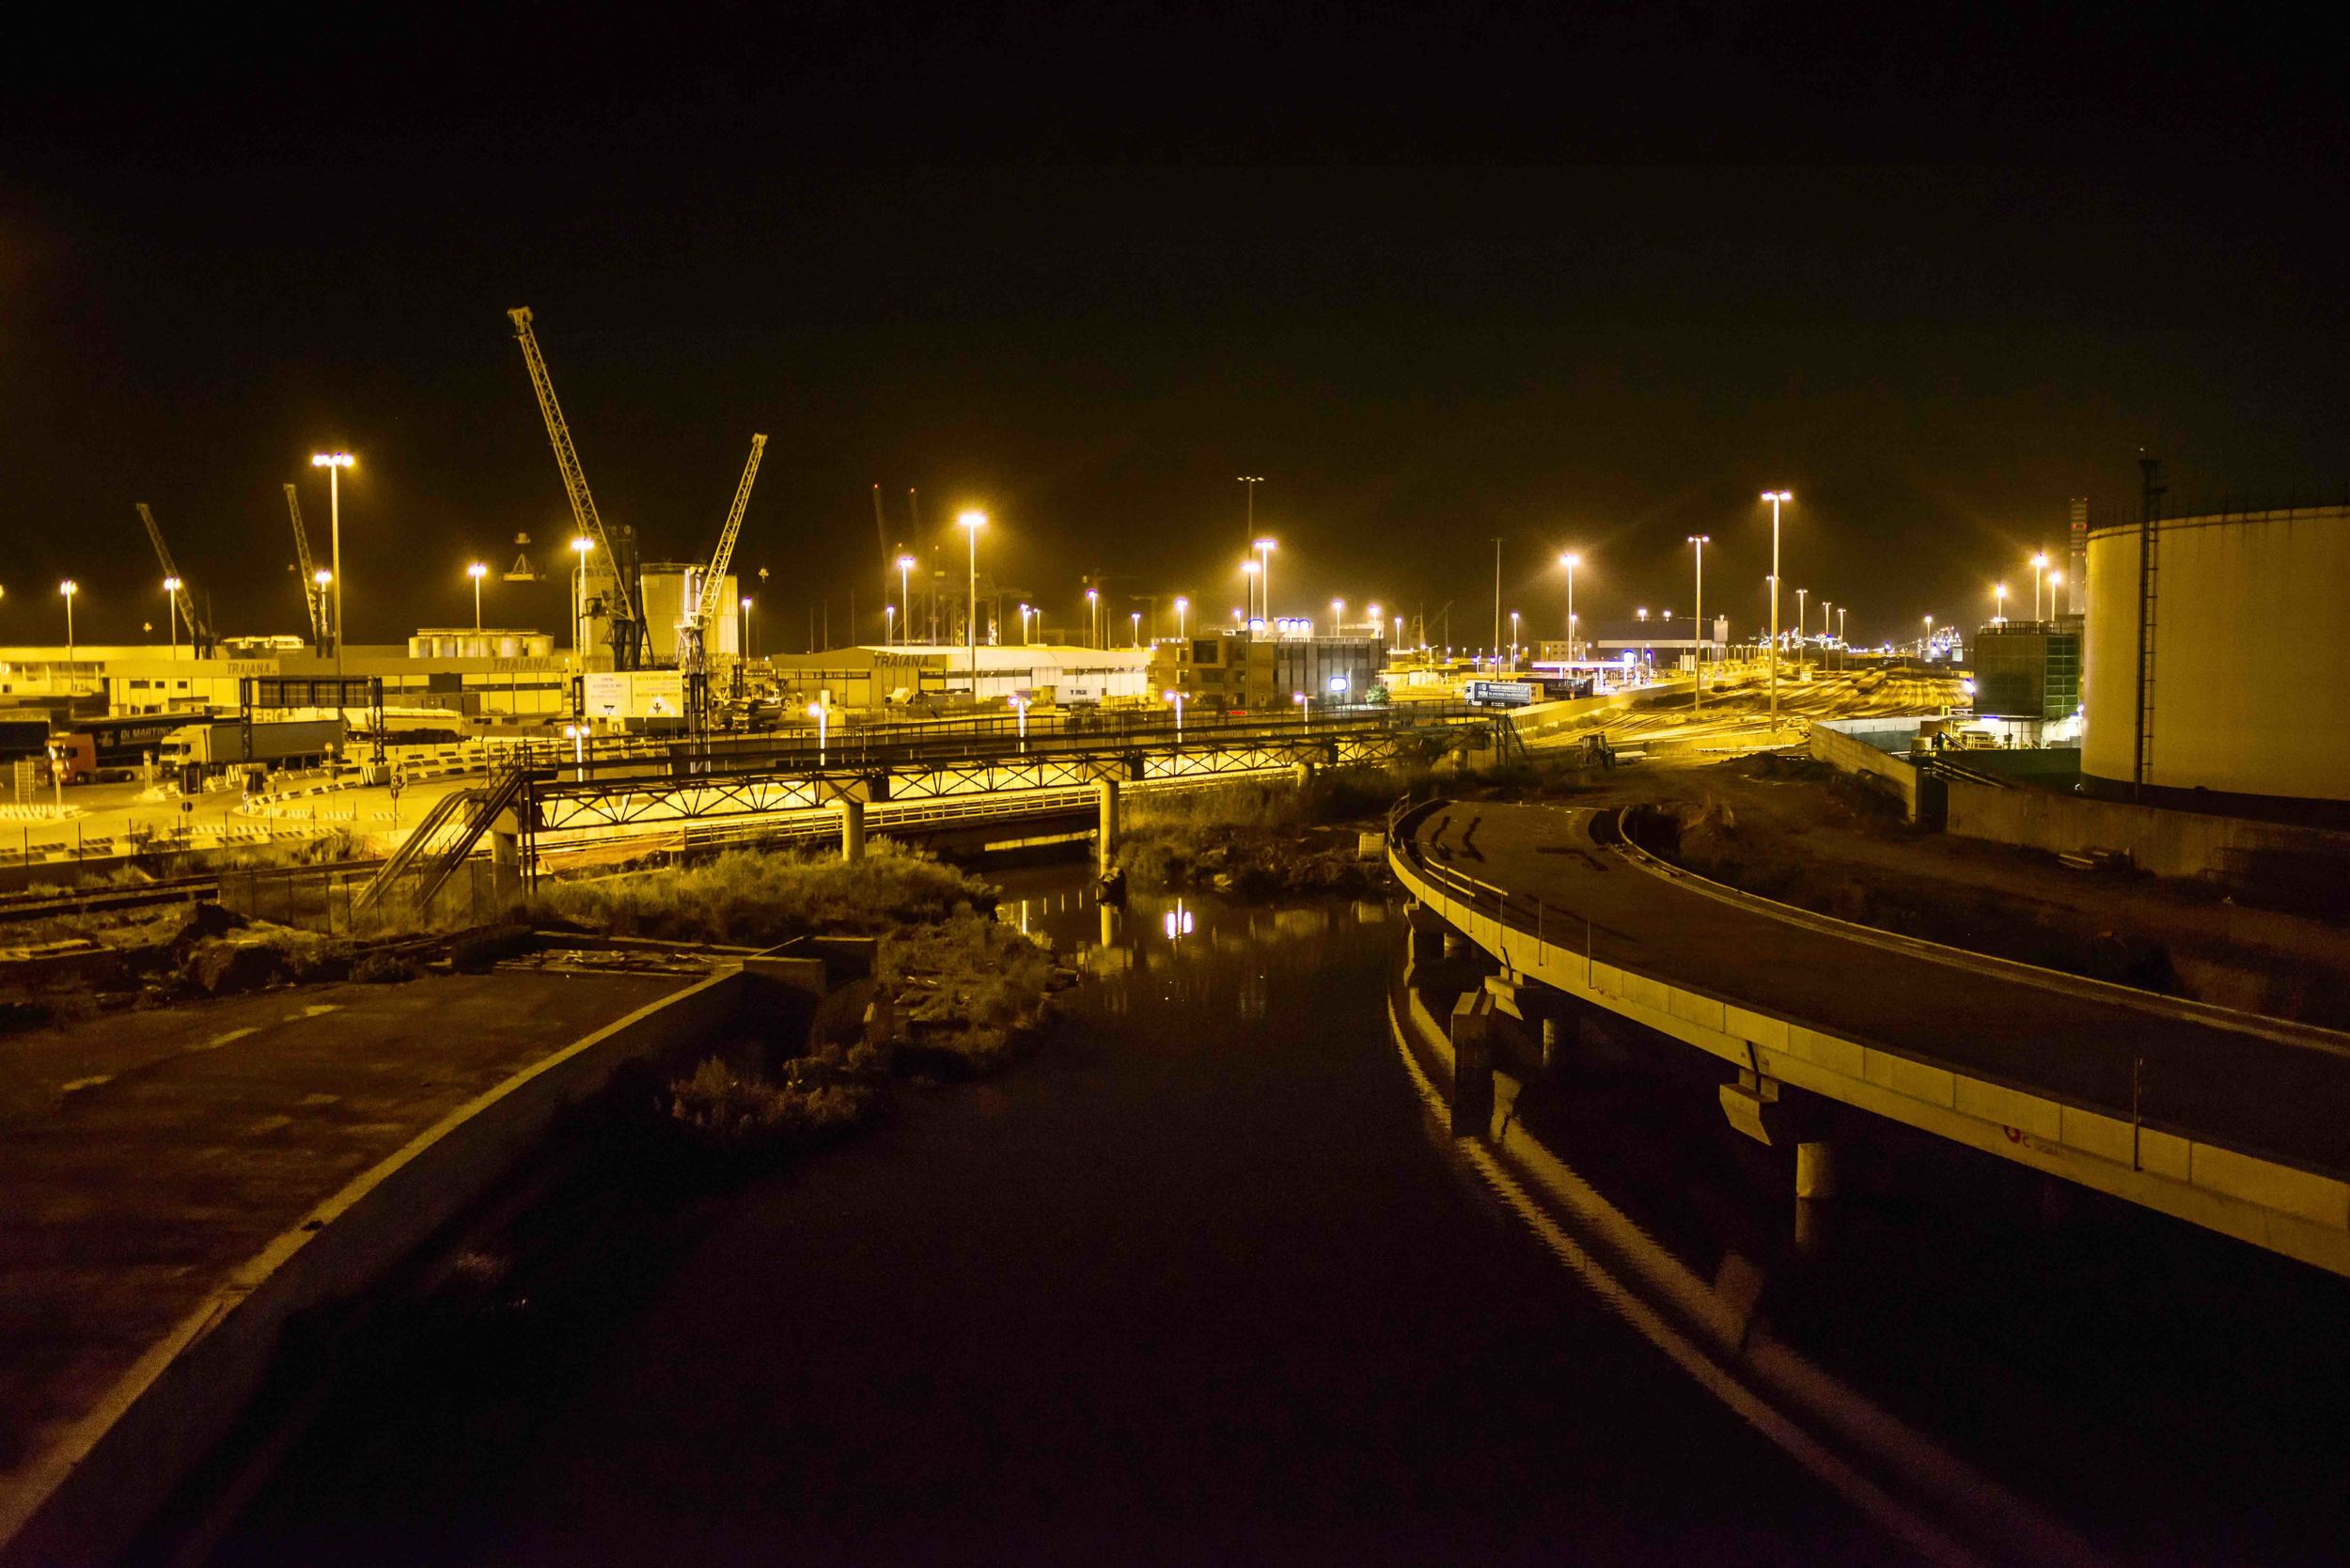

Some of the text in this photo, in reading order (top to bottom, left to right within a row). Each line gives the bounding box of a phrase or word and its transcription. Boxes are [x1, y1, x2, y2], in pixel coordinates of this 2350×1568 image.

[493, 658, 552, 671] TRAIANA
[873, 655, 929, 667] TRAIANA
[227, 663, 271, 675] TRAIANA
[120, 726, 173, 740] DI MARTINO
